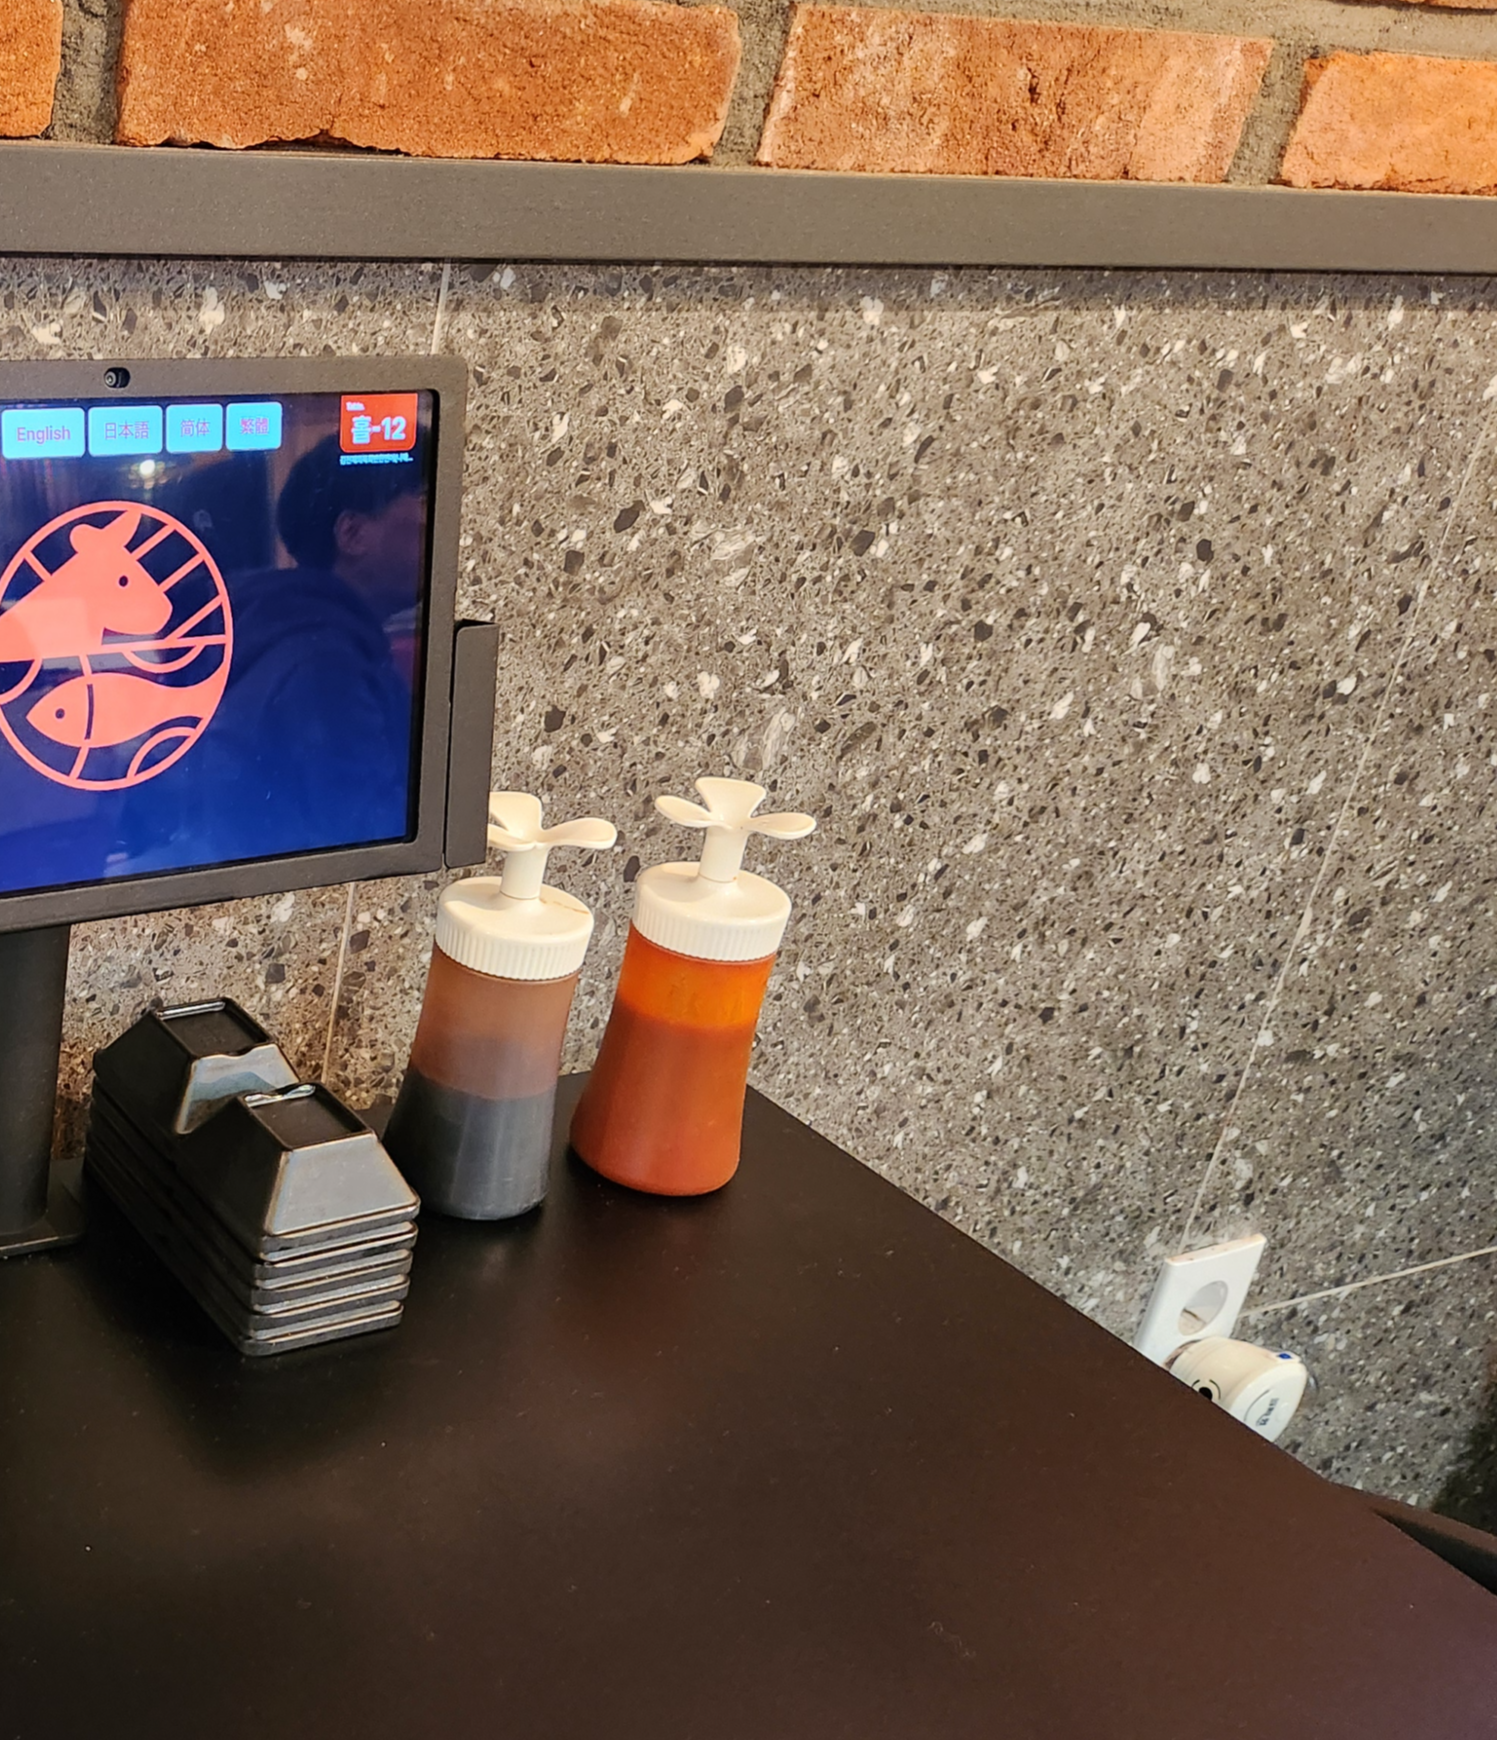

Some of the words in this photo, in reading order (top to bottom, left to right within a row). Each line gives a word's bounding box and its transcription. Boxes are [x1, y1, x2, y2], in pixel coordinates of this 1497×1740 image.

[16, 425, 71, 445] English
[105, 420, 149, 440] 日本語
[180, 418, 210, 437] 简体
